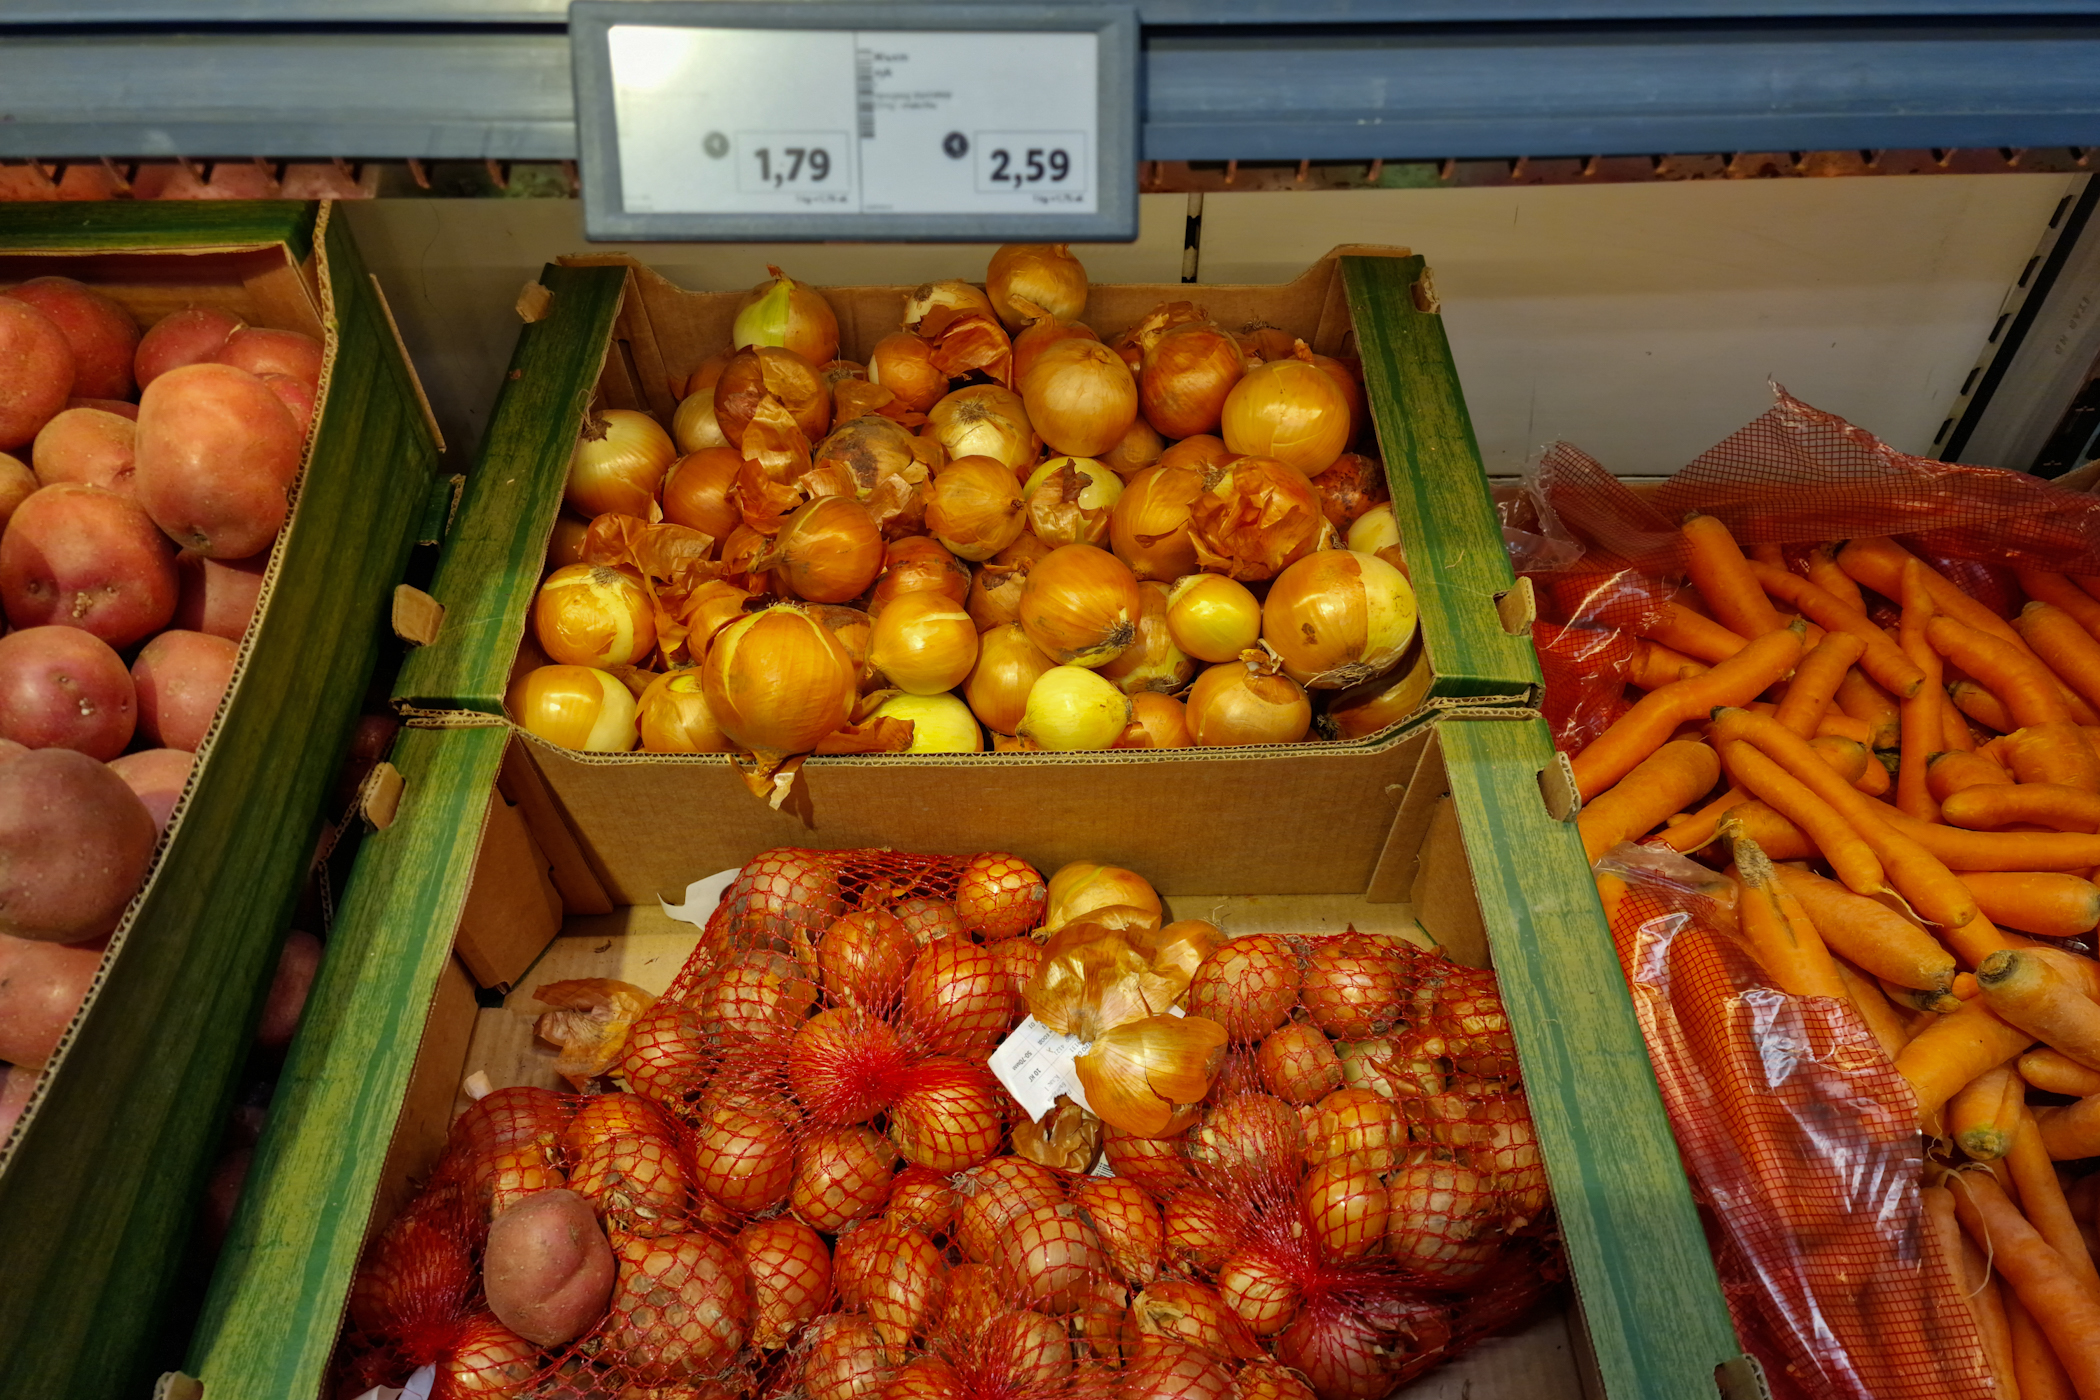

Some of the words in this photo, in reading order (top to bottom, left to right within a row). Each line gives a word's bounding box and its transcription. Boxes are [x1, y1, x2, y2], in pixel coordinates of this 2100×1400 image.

[754, 148, 830, 189] 1,79
[990, 148, 1070, 190] 2,59
[1032, 1067, 1041, 1076] 10
